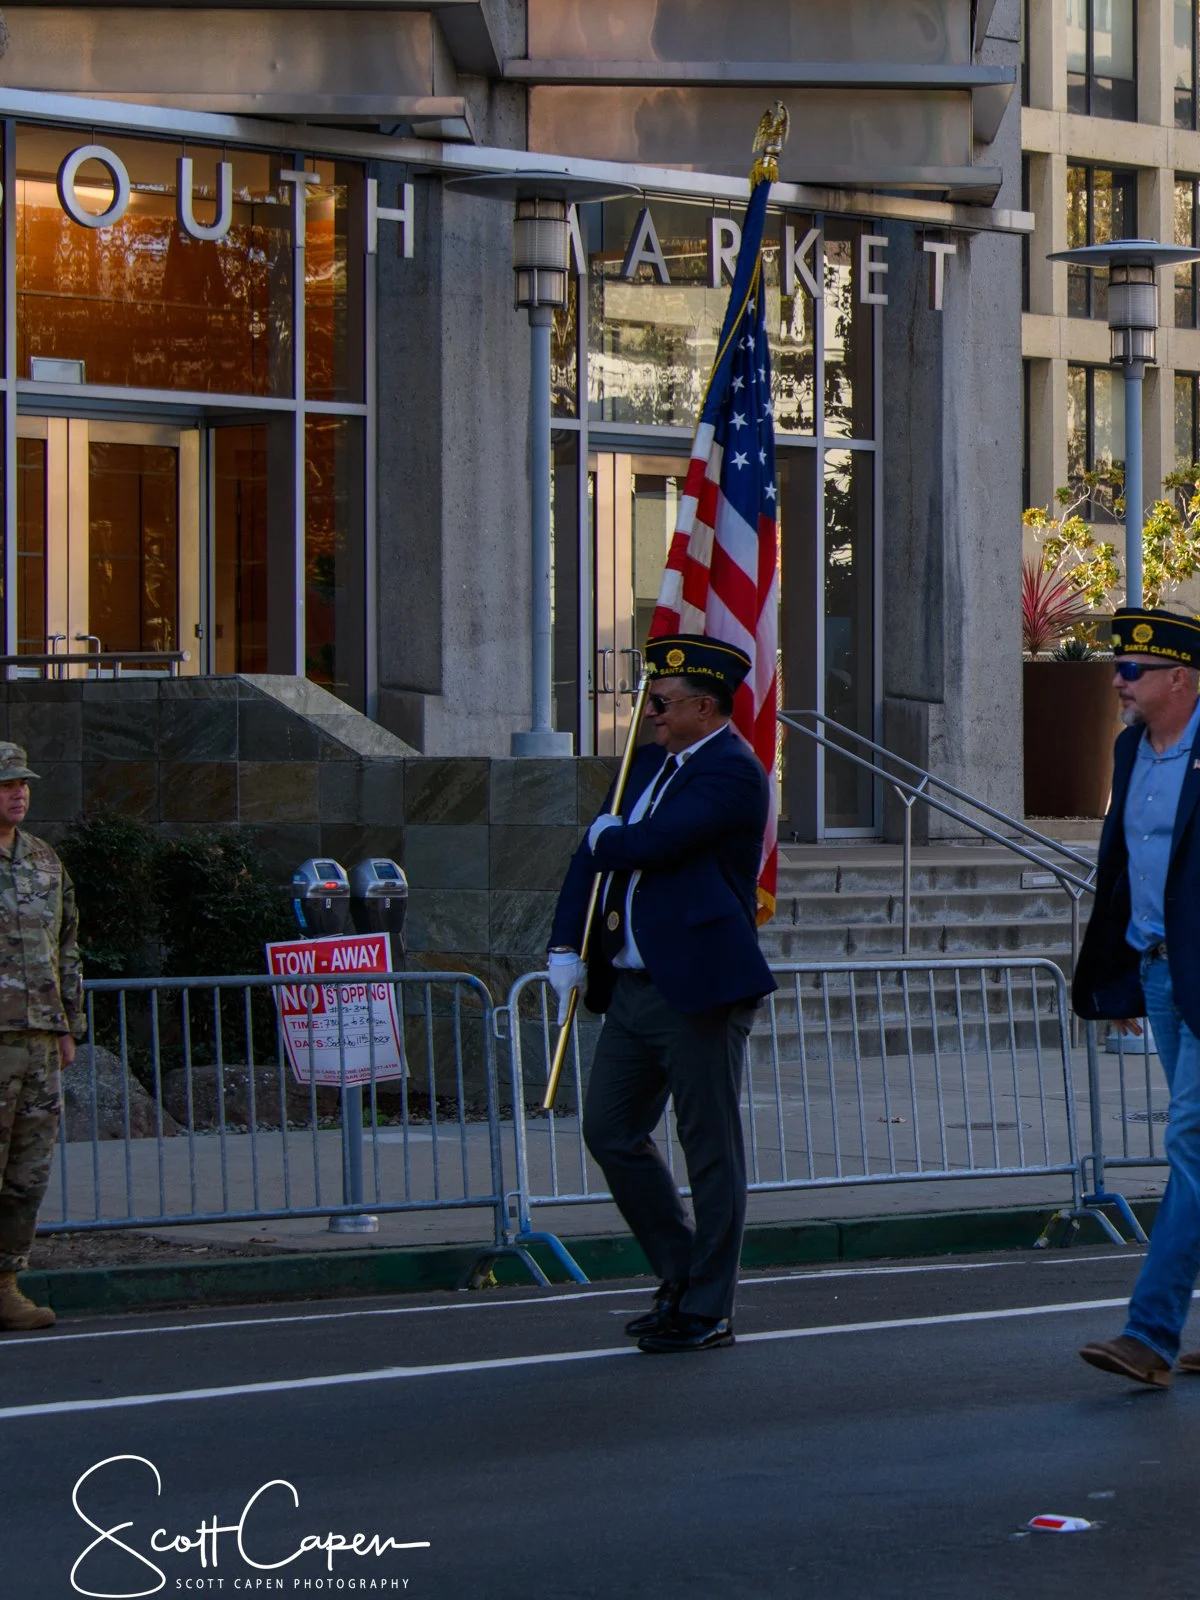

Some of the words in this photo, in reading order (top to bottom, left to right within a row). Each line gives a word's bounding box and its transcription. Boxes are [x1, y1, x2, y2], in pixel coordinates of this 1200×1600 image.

[0, 145, 415, 259] OUTH
[1124, 644, 1149, 652] SANTA
[1150, 645, 1180, 658] CLARA,
[1181, 652, 1191, 661] CA
[659, 667, 685, 675] SANTA
[687, 666, 714, 676] CLARA,
[715, 671, 725, 680] CA
[275, 950, 316, 974] TOW
[331, 944, 380, 971] AWAY
[272, 983, 320, 1011] NO
